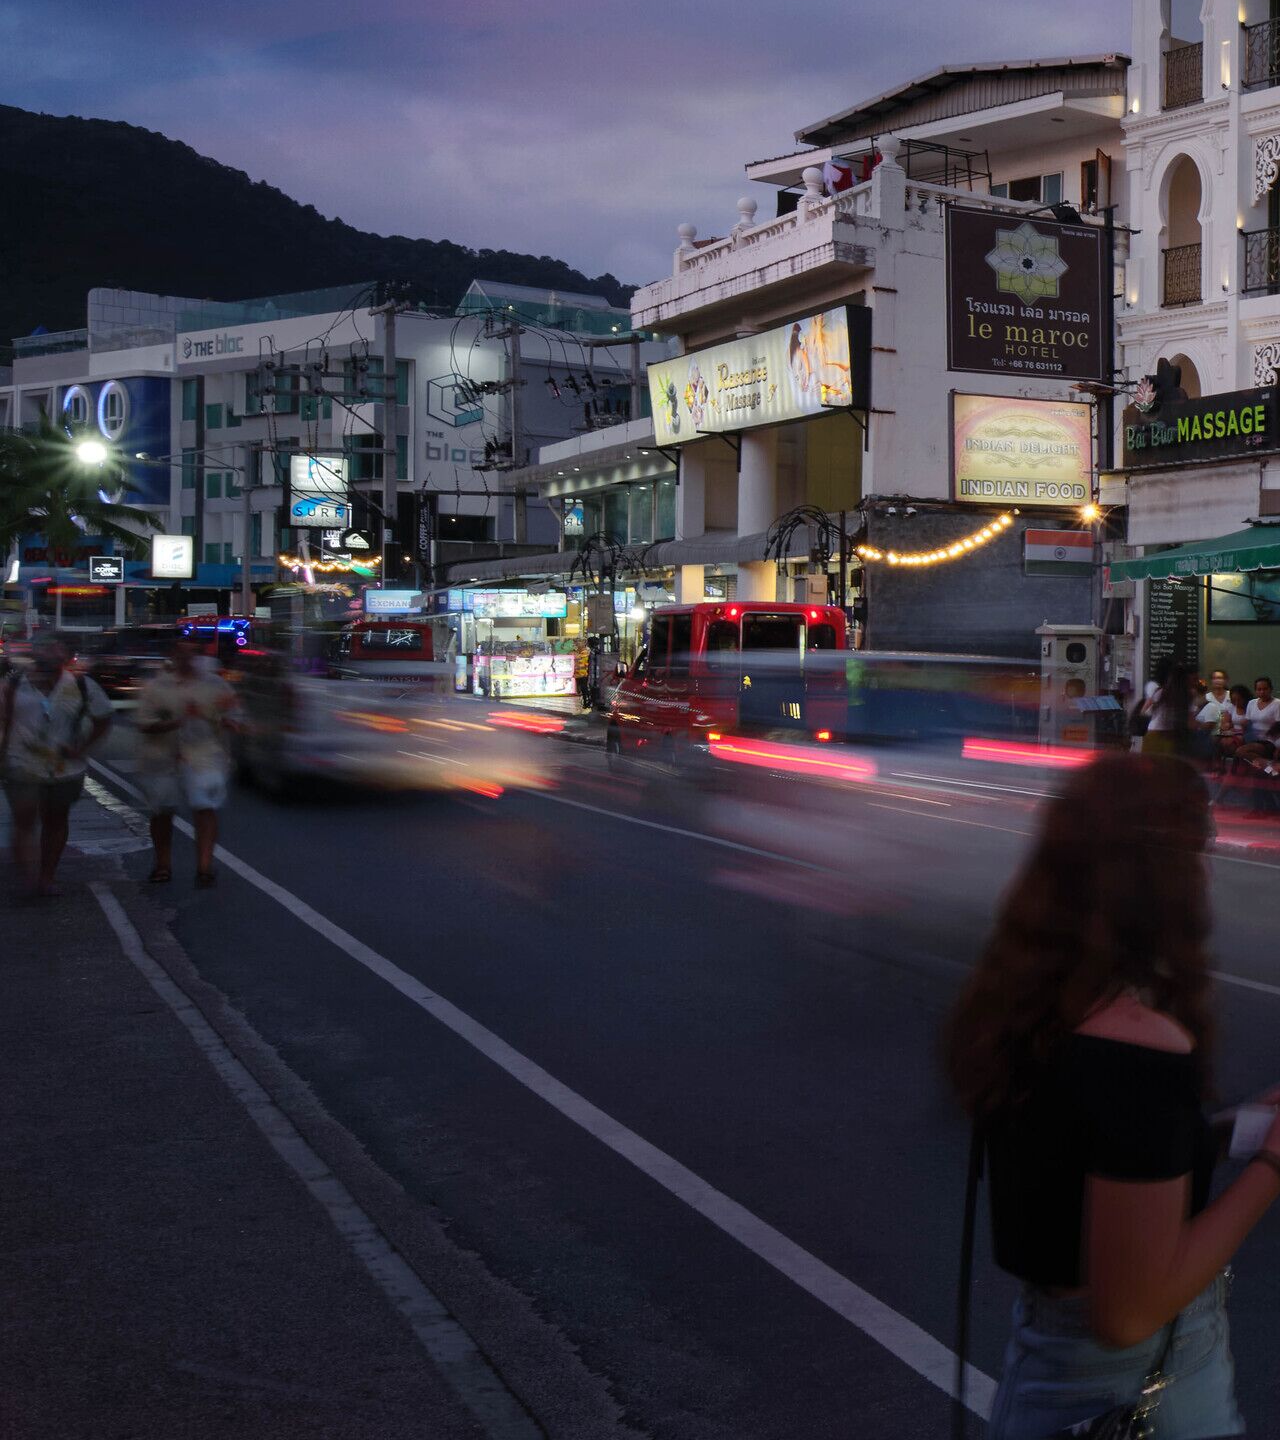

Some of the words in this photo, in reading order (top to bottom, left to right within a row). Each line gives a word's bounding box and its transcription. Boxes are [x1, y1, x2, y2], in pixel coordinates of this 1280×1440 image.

[965, 297, 1015, 318] โรงแรม
[1019, 306, 1044, 319] เลอ
[967, 314, 993, 339] le
[1004, 324, 1089, 348] maroc
[194, 340, 214, 357] THE
[215, 333, 244, 354] bloc
[1005, 344, 1060, 359] HOTEL
[1024, 361, 1035, 370] 76
[726, 391, 761, 413] Massage
[425, 430, 445, 439] THE
[1177, 404, 1266, 443] MASSAGE
[426, 441, 484, 463] bloc
[965, 437, 1016, 453] INDIAN
[1019, 440, 1081, 456] DELIGHT
[960, 478, 1029, 498] INDIAN
[1034, 481, 1086, 500] FOOD
[295, 505, 344, 519] SURF
